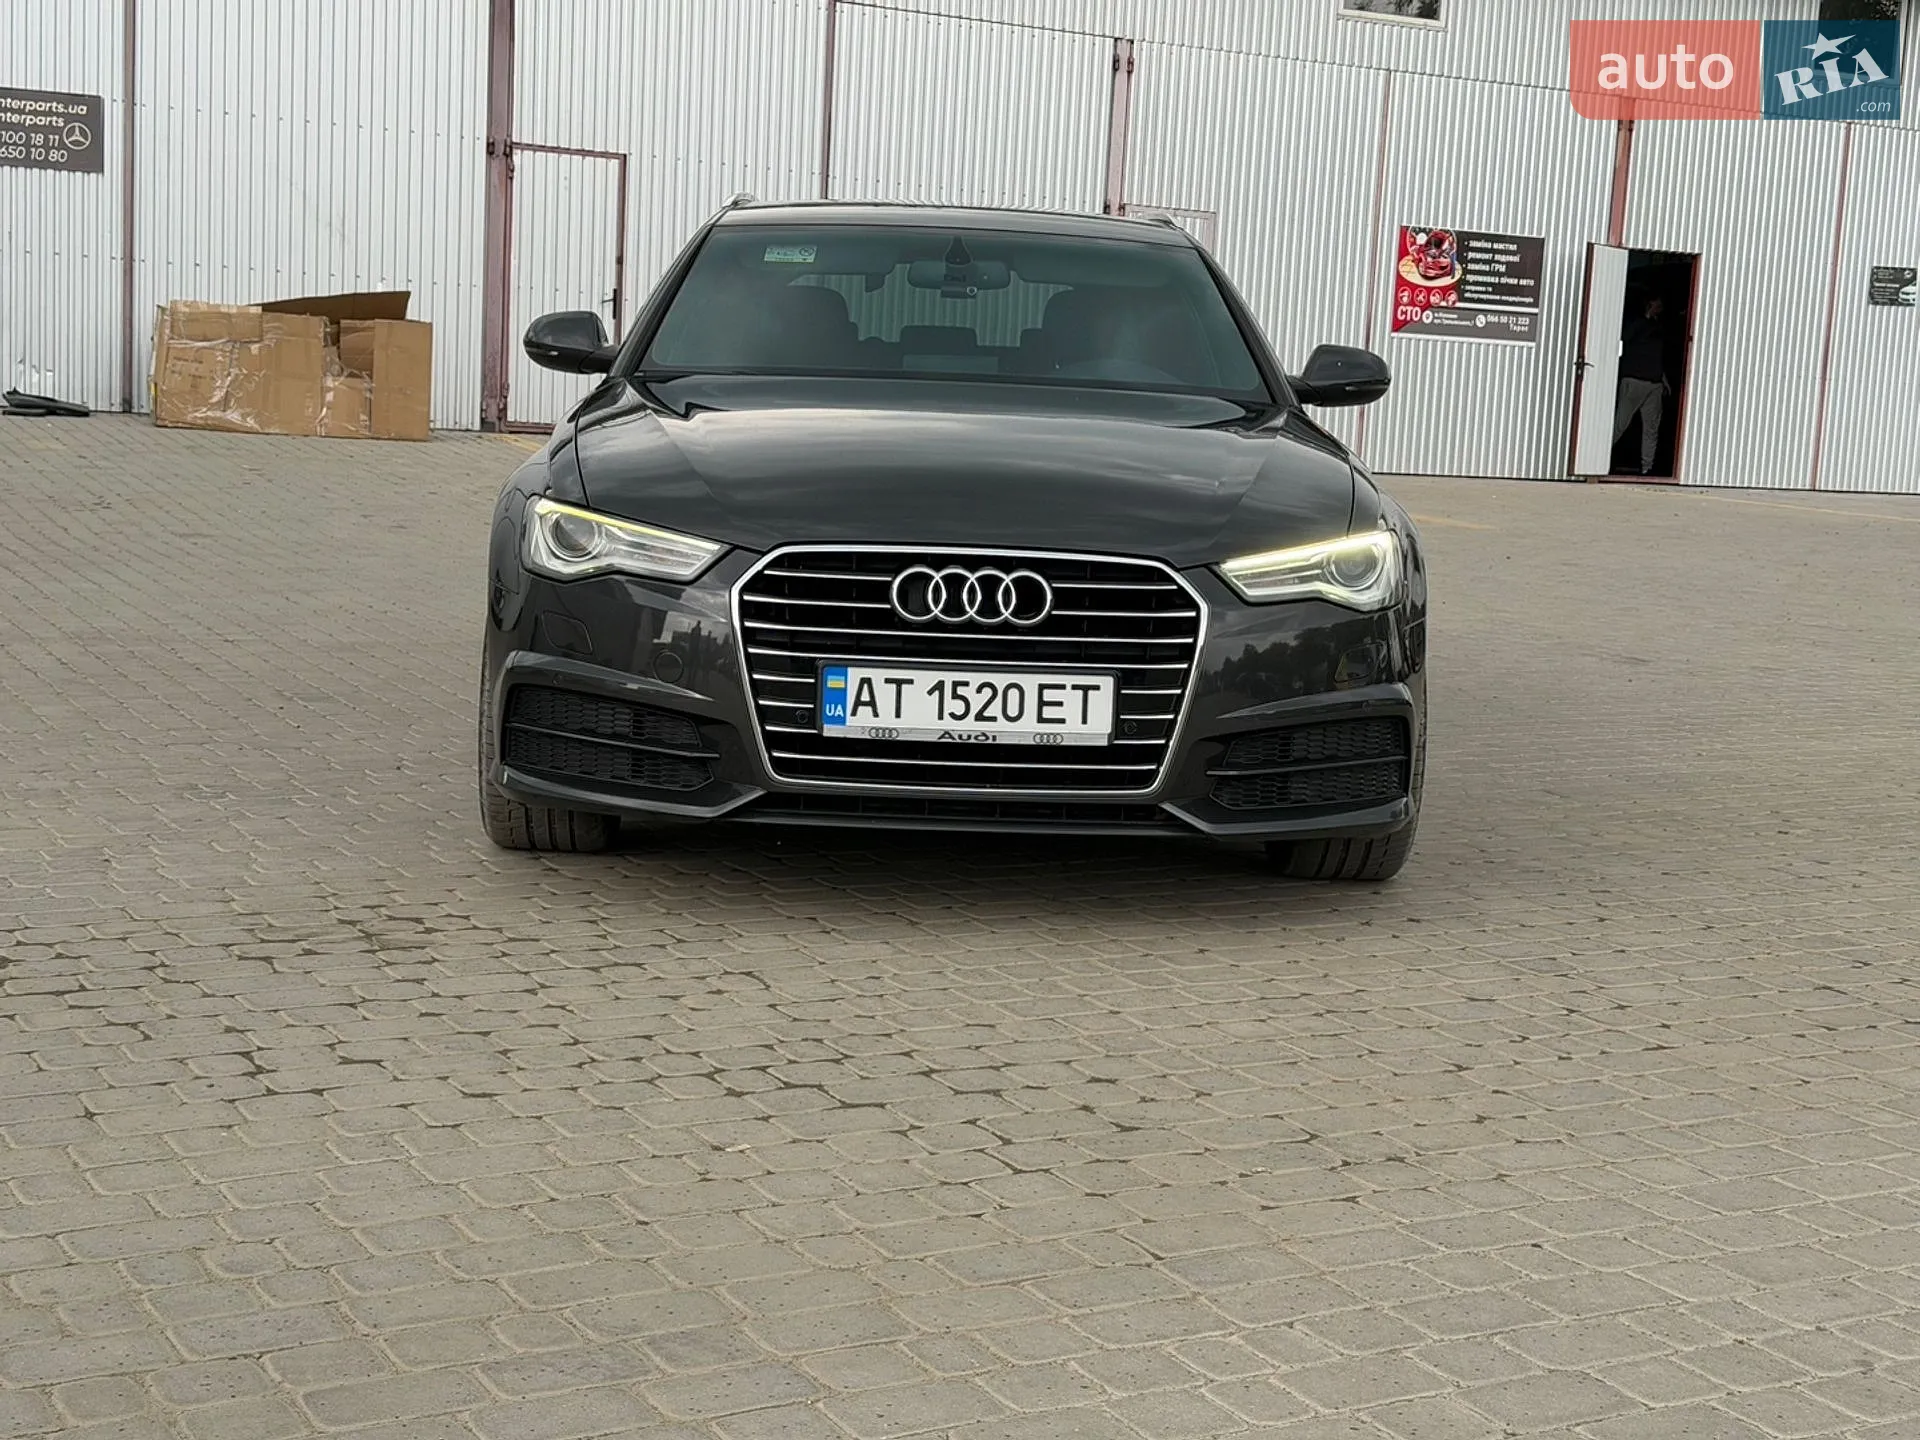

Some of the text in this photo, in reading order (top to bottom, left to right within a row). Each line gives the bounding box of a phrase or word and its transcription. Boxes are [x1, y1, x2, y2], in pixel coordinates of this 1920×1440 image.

[30, 133, 44, 146] 18
[48, 134, 59, 147] 11
[0, 145, 67, 162] 650 10 80
[1397, 305, 1421, 320] СТО
[850, 677, 1100, 725] AT 1520 ET
[826, 704, 844, 718] UA
[937, 730, 997, 743] Audi
